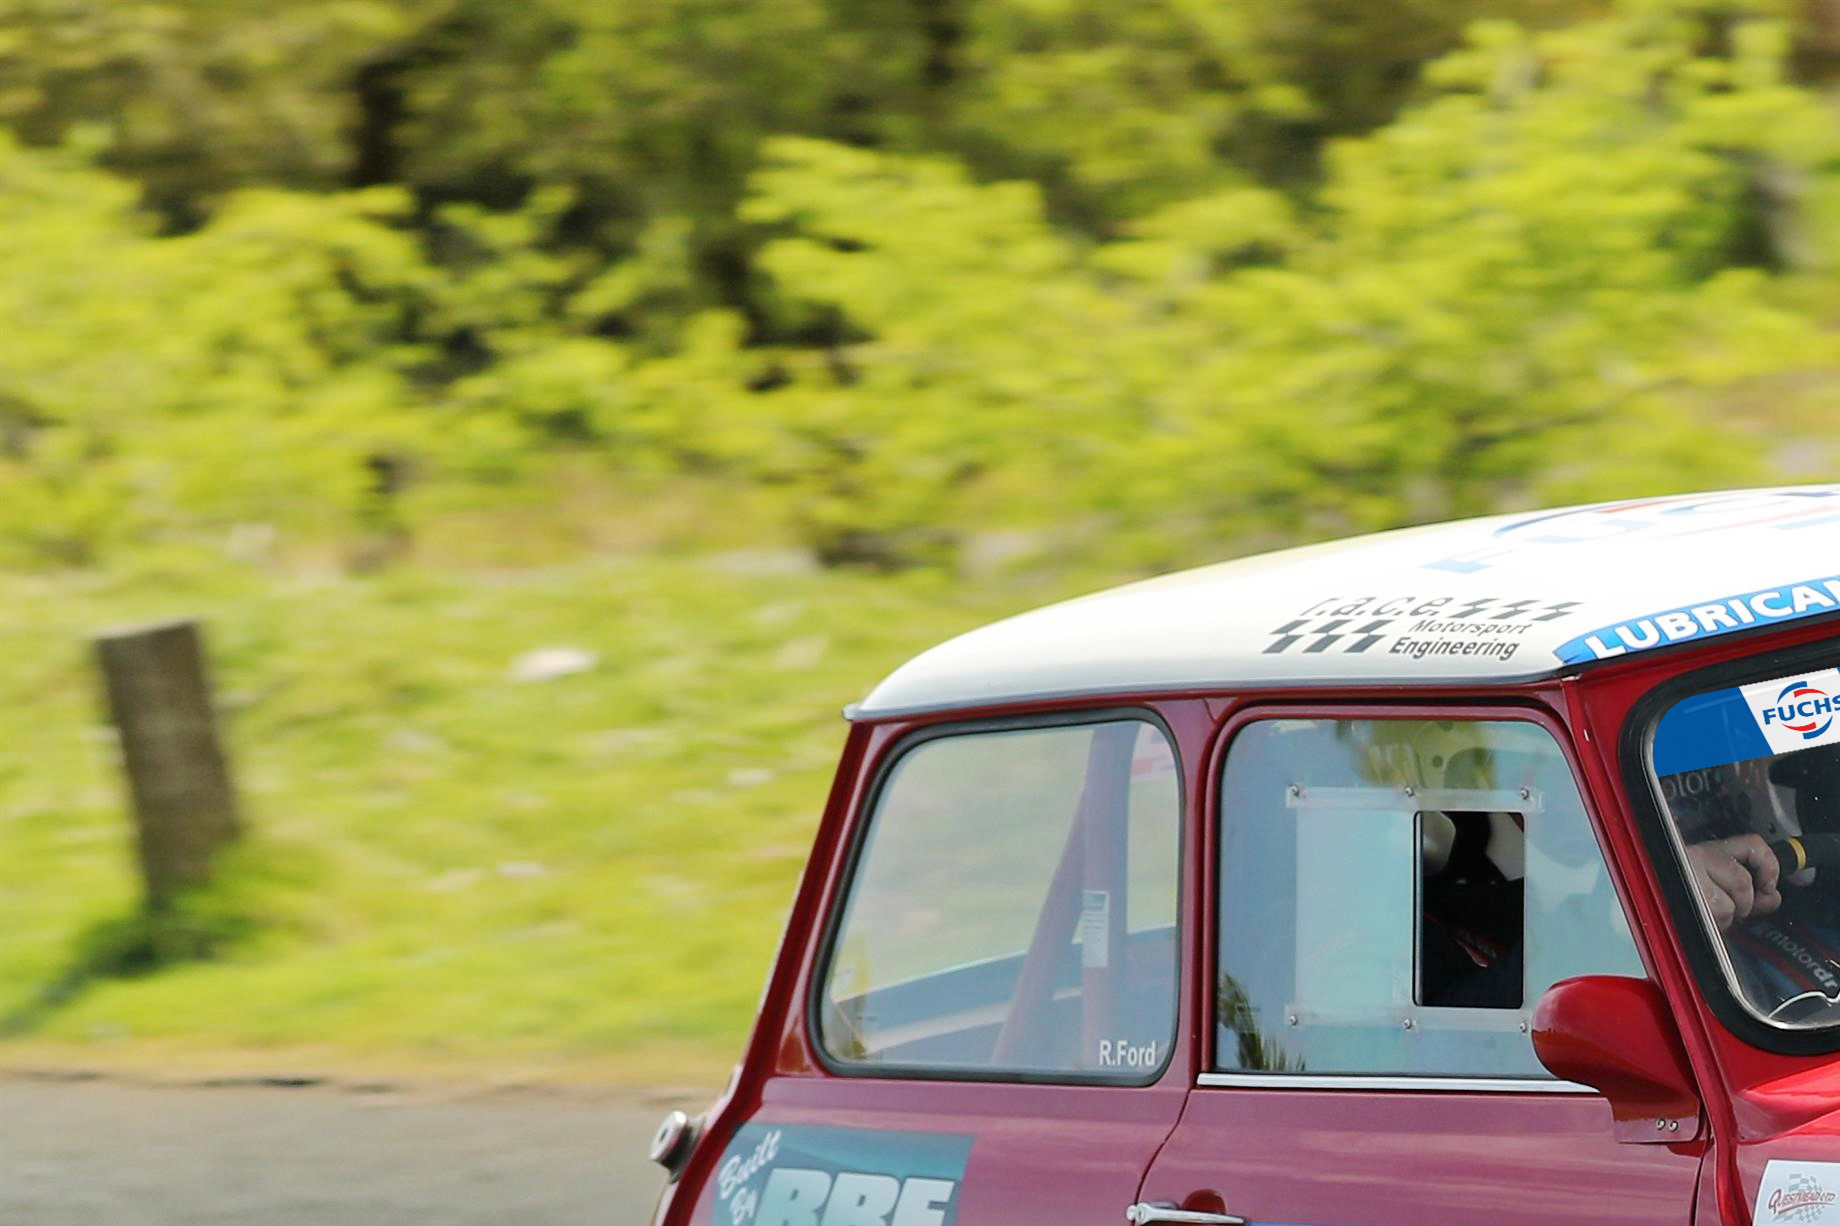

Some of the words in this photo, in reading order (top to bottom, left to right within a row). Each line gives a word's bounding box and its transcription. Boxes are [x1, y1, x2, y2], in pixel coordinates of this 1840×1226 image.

[1407, 619, 1533, 637] Motorsport
[1388, 636, 1521, 661] Engineering
[1100, 1039, 1156, 1067] R.Ford
